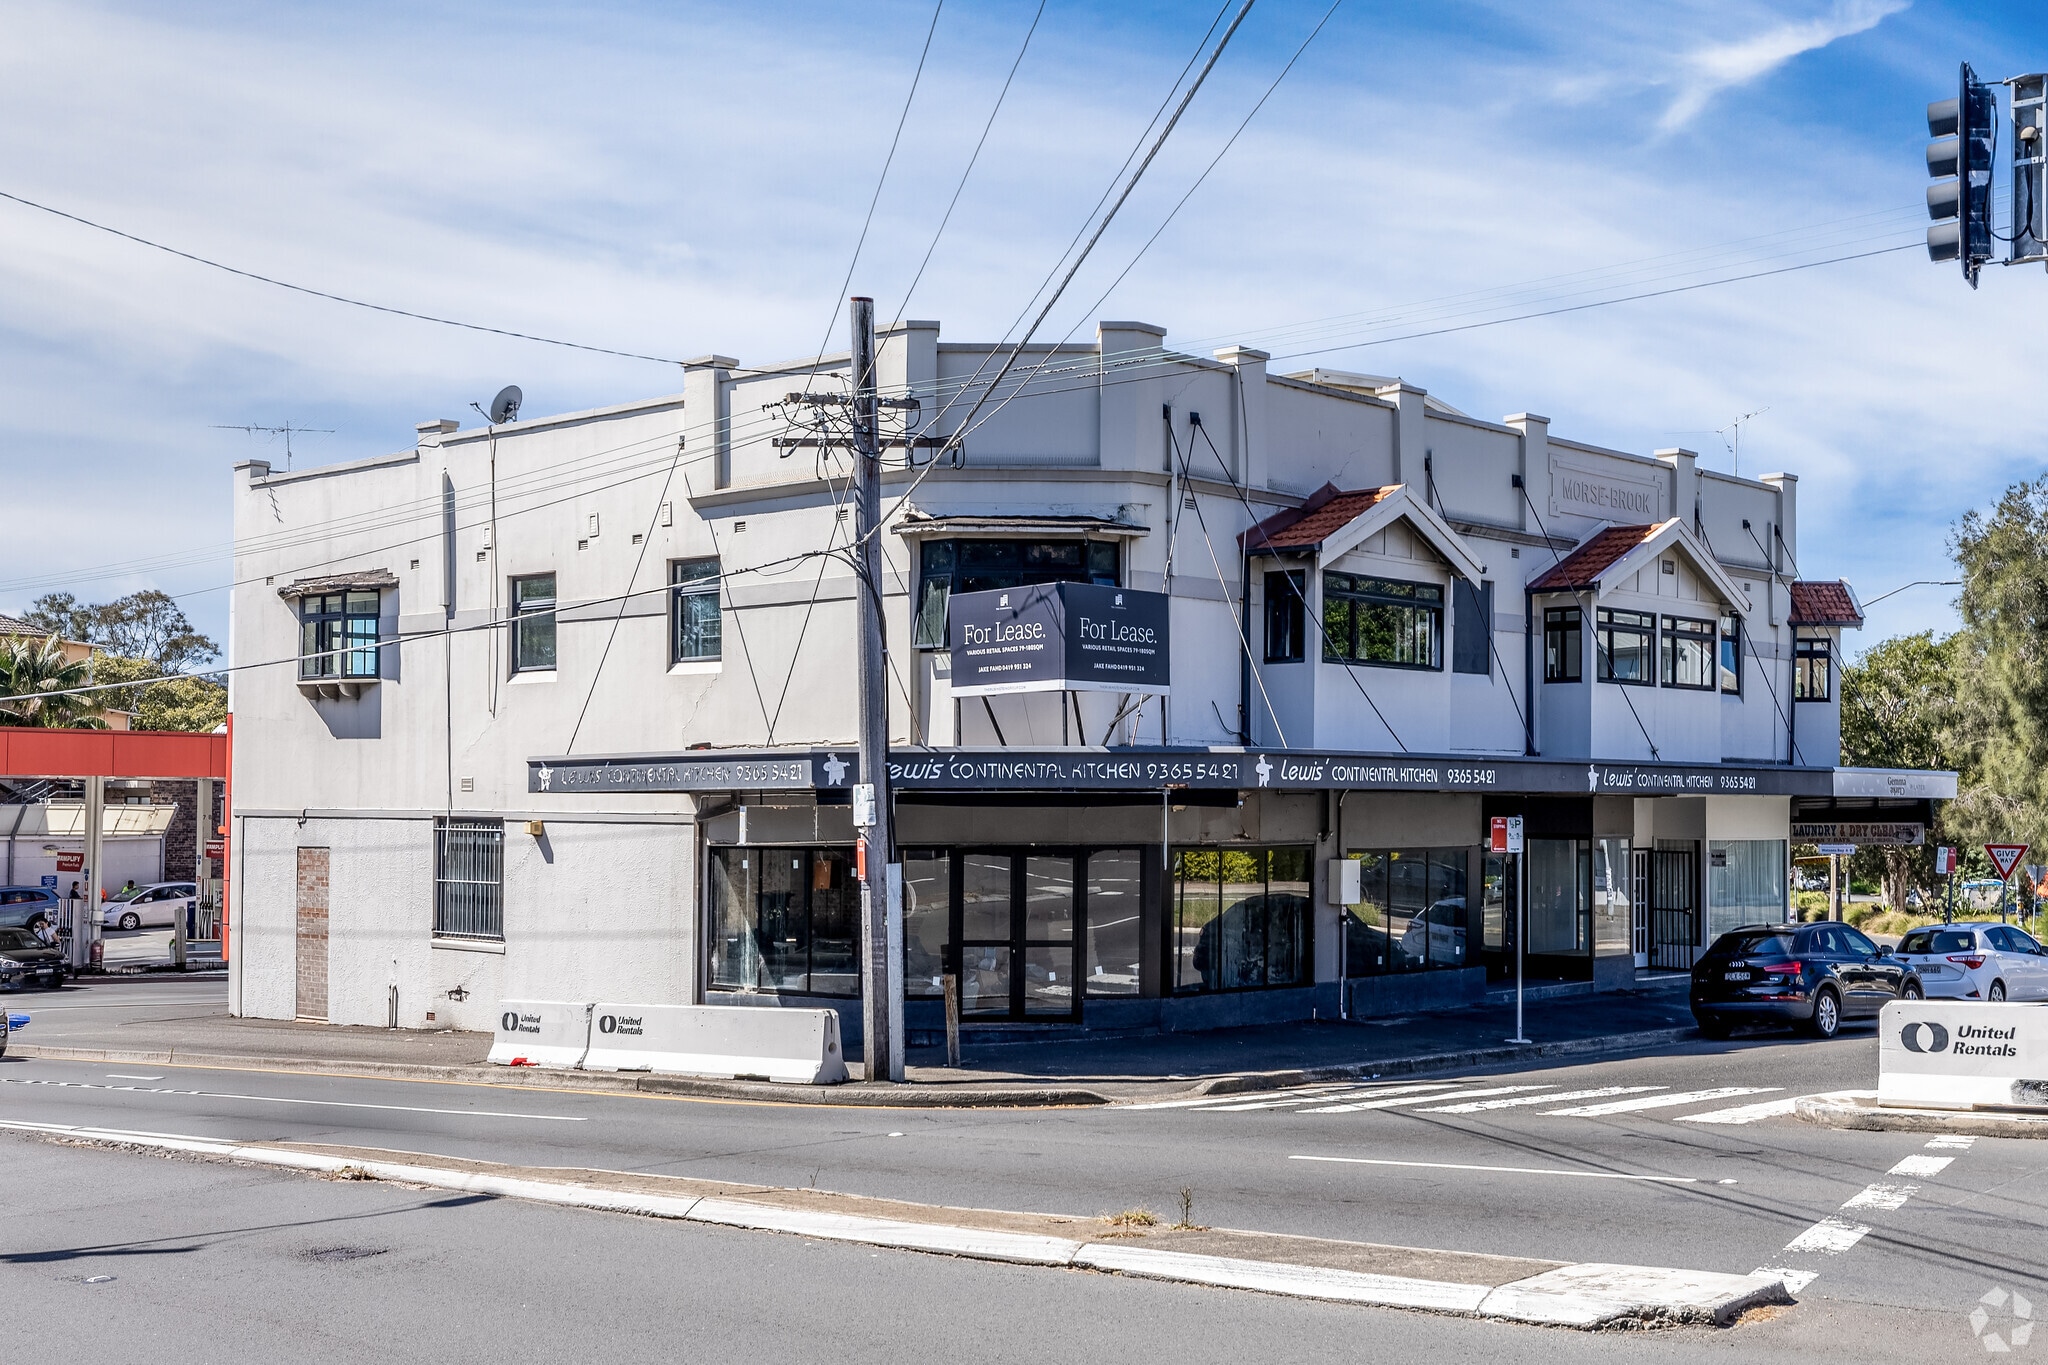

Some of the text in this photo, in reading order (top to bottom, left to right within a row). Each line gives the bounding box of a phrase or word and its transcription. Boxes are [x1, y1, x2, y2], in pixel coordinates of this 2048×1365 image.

[1562, 477, 1650, 514] MORSE-BROOK
[964, 621, 1046, 645] For Lease.
[1080, 617, 1157, 644] For Lease.
[967, 648, 986, 656] VARIOUS
[986, 647, 1001, 655] RETAIL
[1002, 645, 1018, 653] SPACES
[608, 766, 680, 784] CONTINENTAL
[684, 765, 730, 782] KITCHEN
[951, 762, 1067, 780] CONTINENTAL
[1072, 762, 1140, 780] KITCHEN
[1332, 765, 1398, 783] CONTINENTAL
[1400, 767, 1438, 784] KITCHEN
[1637, 773, 1685, 788] CONTINENTAL
[1686, 775, 1713, 788] KITCHEN
[1792, 824, 1837, 838] LAUNDRY
[1839, 824, 1845, 838] &
[1849, 824, 1868, 838] DRY
[1996, 850, 2016, 858] GIVE
[520, 1014, 541, 1024] United
[618, 1016, 643, 1026] United
[518, 1023, 540, 1034] Rentals
[616, 1025, 643, 1035] Rentals
[1957, 1025, 2016, 1040] United
[1952, 1041, 2017, 1057] Rentals
